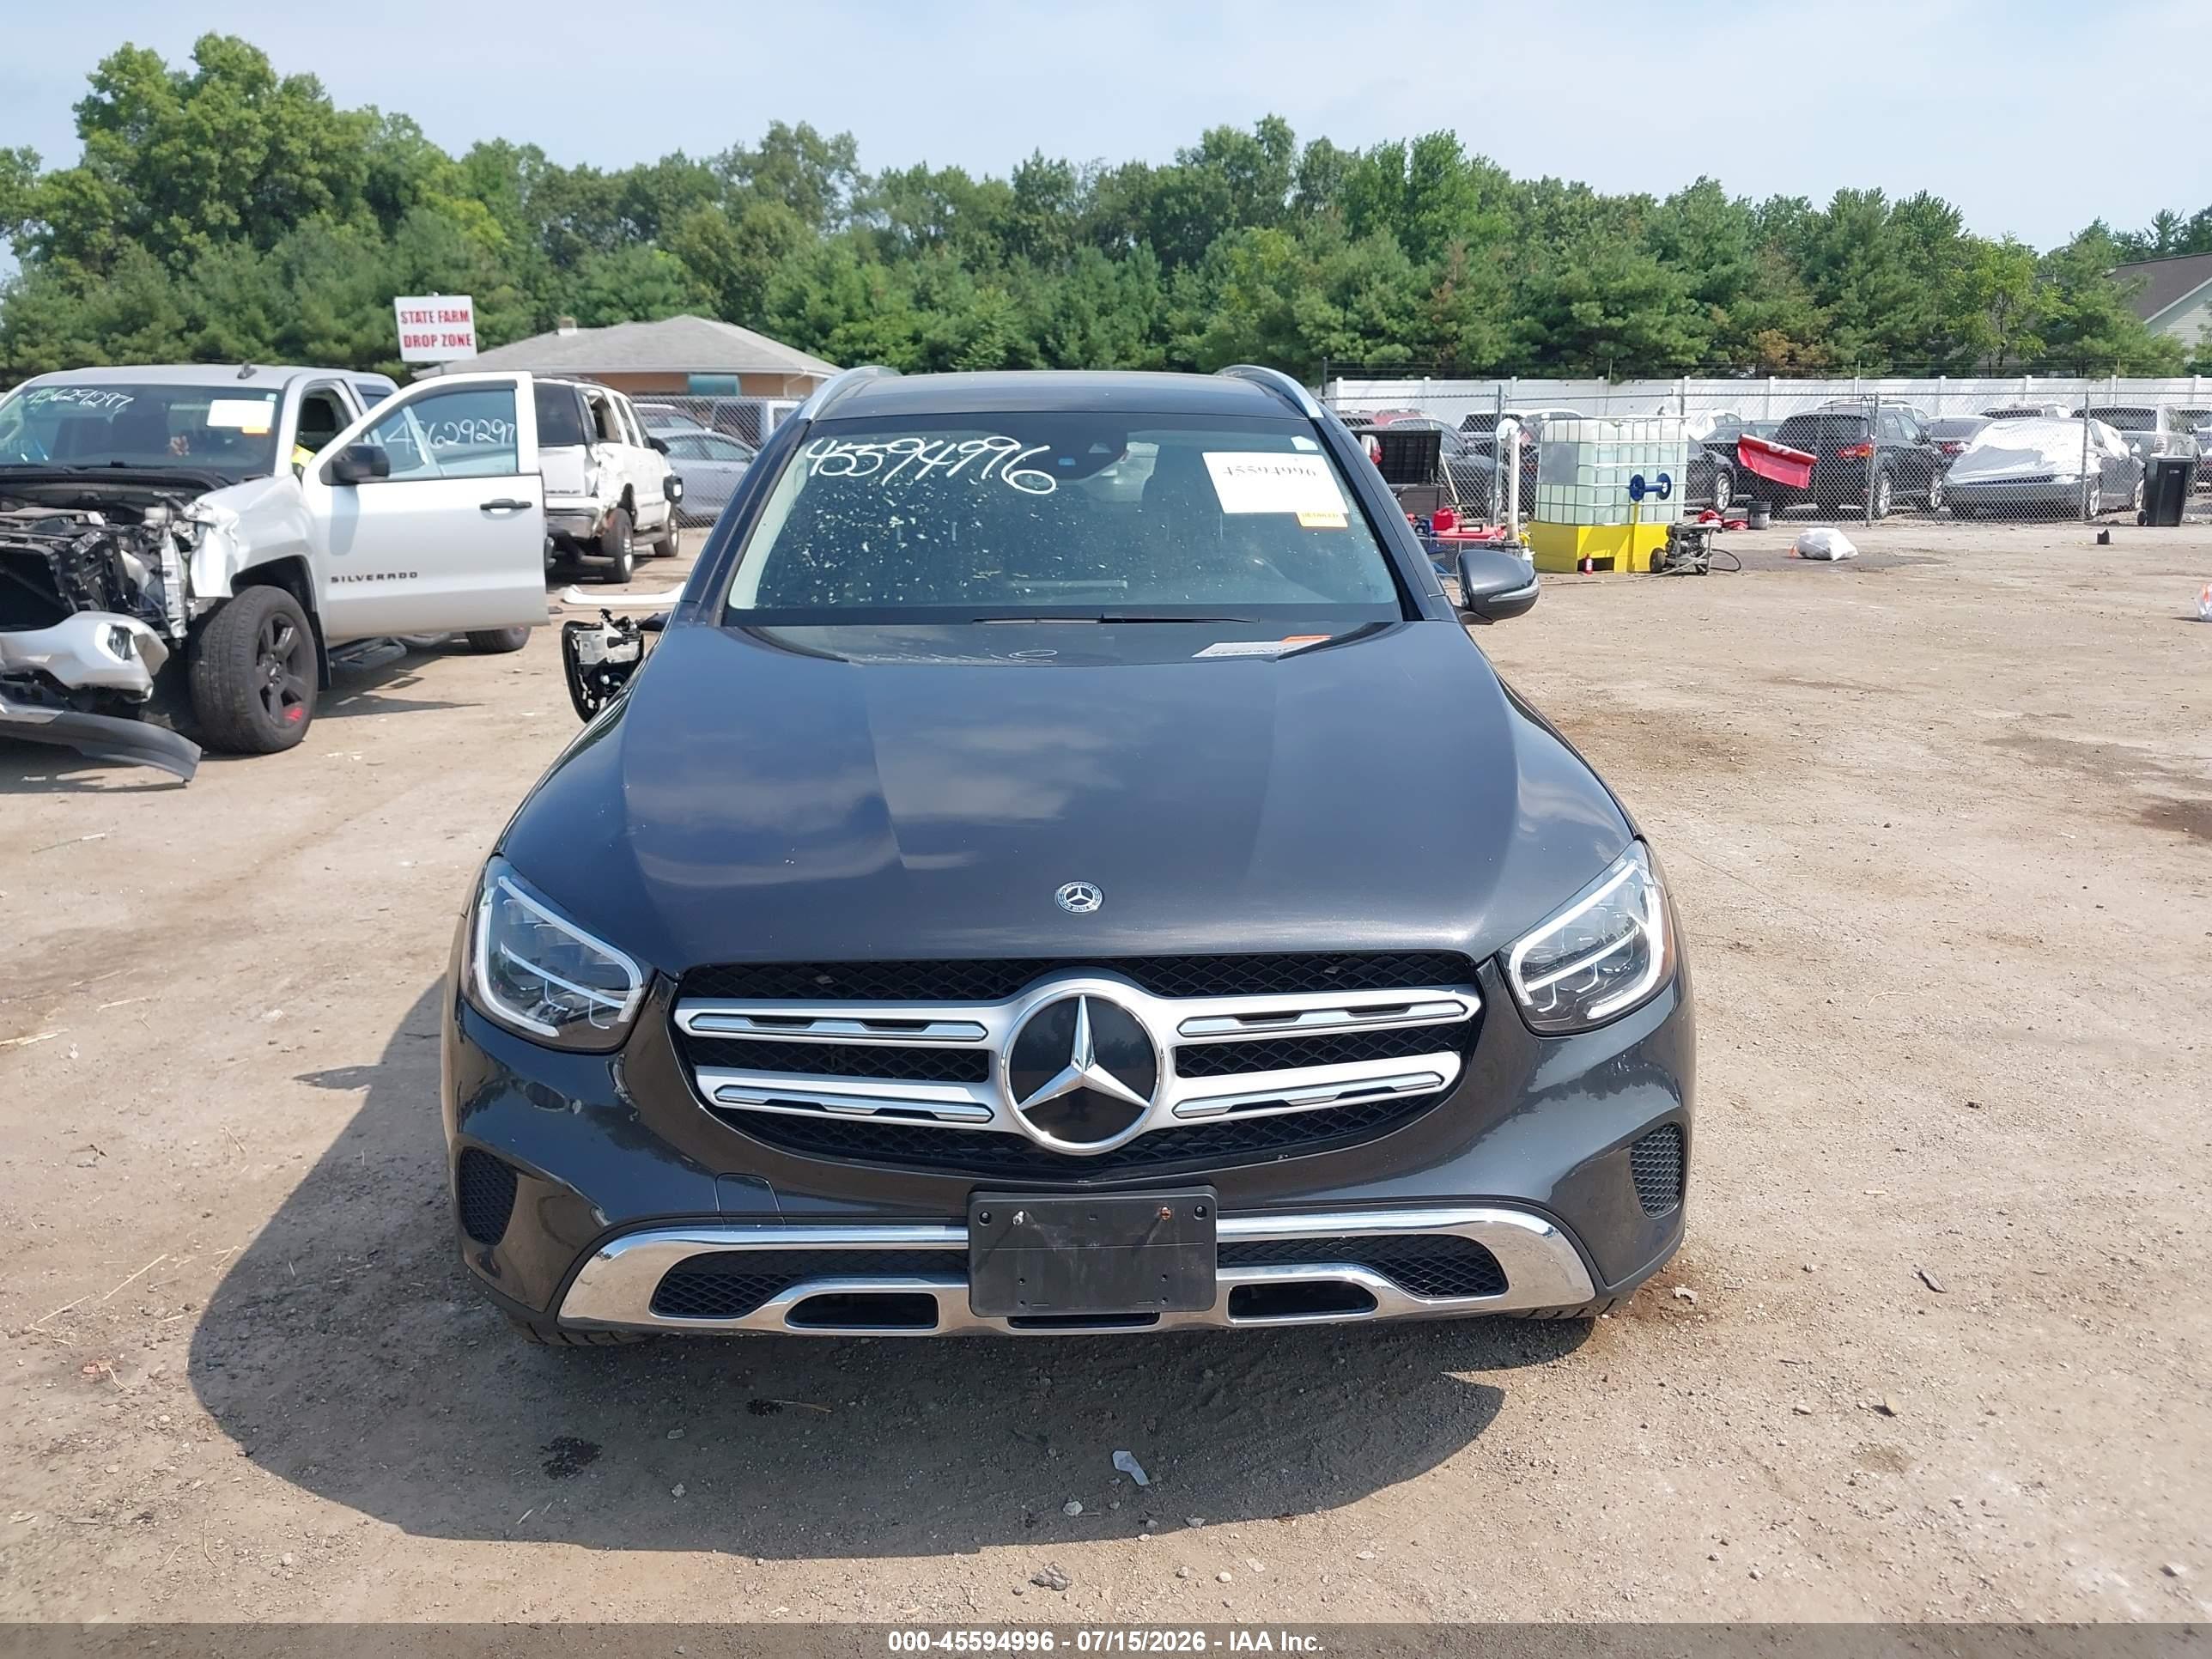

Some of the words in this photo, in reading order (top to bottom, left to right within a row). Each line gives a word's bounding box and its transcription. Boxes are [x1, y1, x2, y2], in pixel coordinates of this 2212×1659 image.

[400, 310, 435, 324] STATE
[438, 309, 470, 323] FARM
[404, 334, 438, 348] DROP
[441, 333, 471, 347] ZONE
[805, 436, 1057, 495] 45594996
[331, 572, 418, 583] SILVERADO
